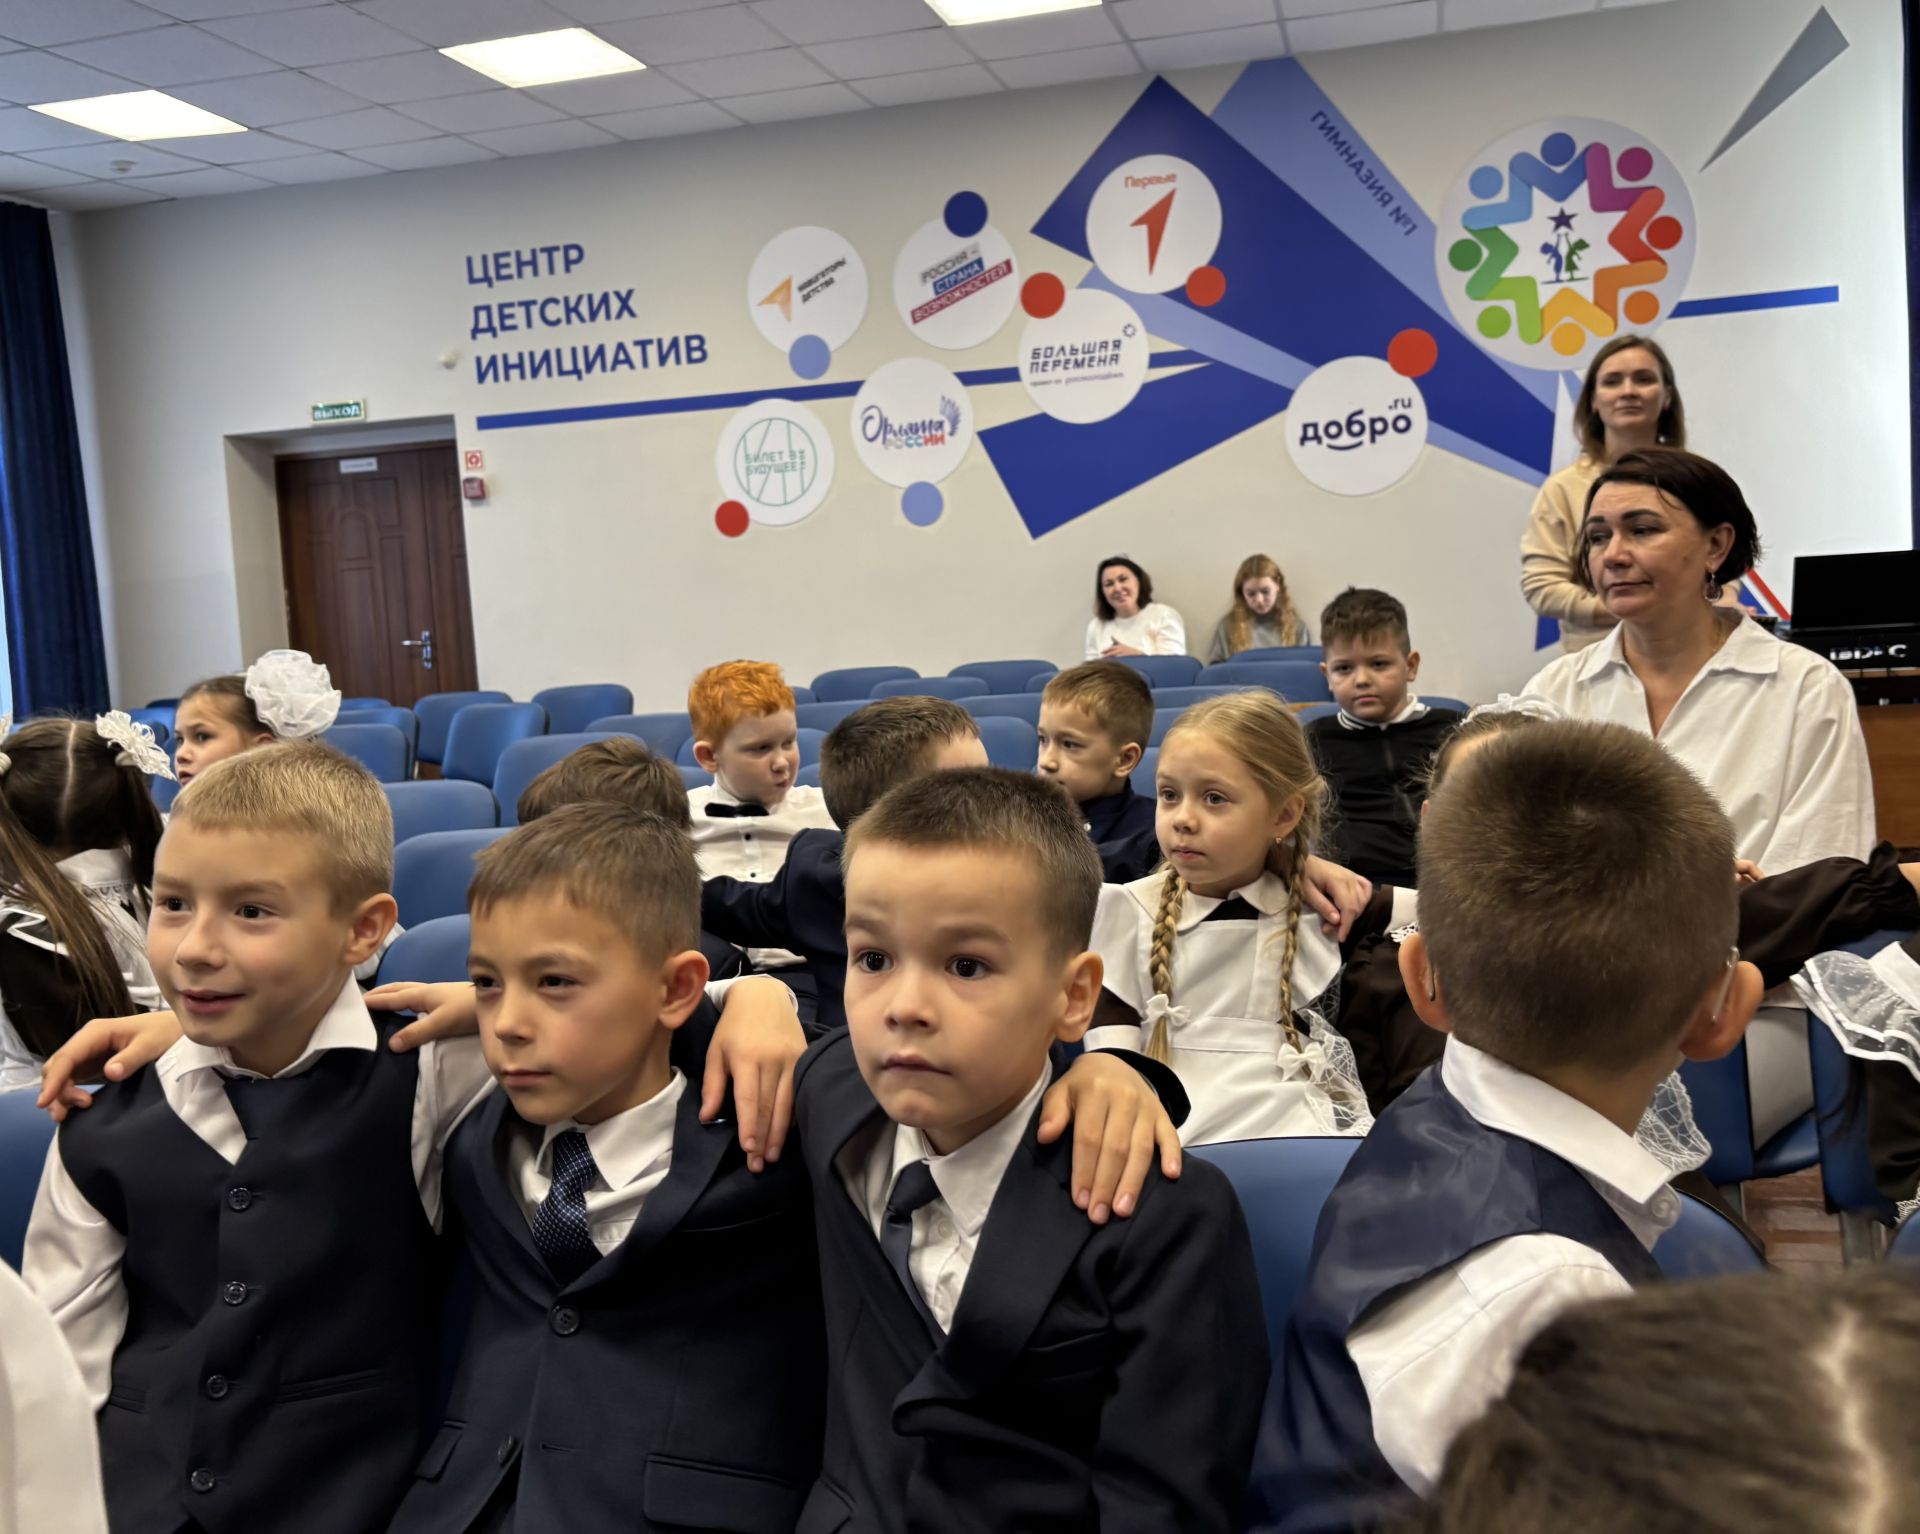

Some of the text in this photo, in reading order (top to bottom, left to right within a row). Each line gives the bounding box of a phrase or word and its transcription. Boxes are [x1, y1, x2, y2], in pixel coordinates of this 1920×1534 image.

[1124, 173, 1177, 190] Первые
[1310, 110, 1418, 236] ГИМНАЗИЯ №1
[466, 244, 585, 288] ЦЕНТР
[935, 261, 982, 293] СТРАНА
[471, 289, 638, 341] ДЕТСКИХ
[475, 334, 708, 384] ИНИЦИАТИВ
[1031, 339, 1122, 360] БОЛЬШАЯ
[1030, 353, 1120, 374] ПЕРЕМЕНА
[314, 403, 360, 420] ВЫХОД
[1299, 408, 1412, 446] добро
[745, 450, 784, 465] БИЛЕТ
[745, 460, 798, 475] БУДУЩЕЕ
